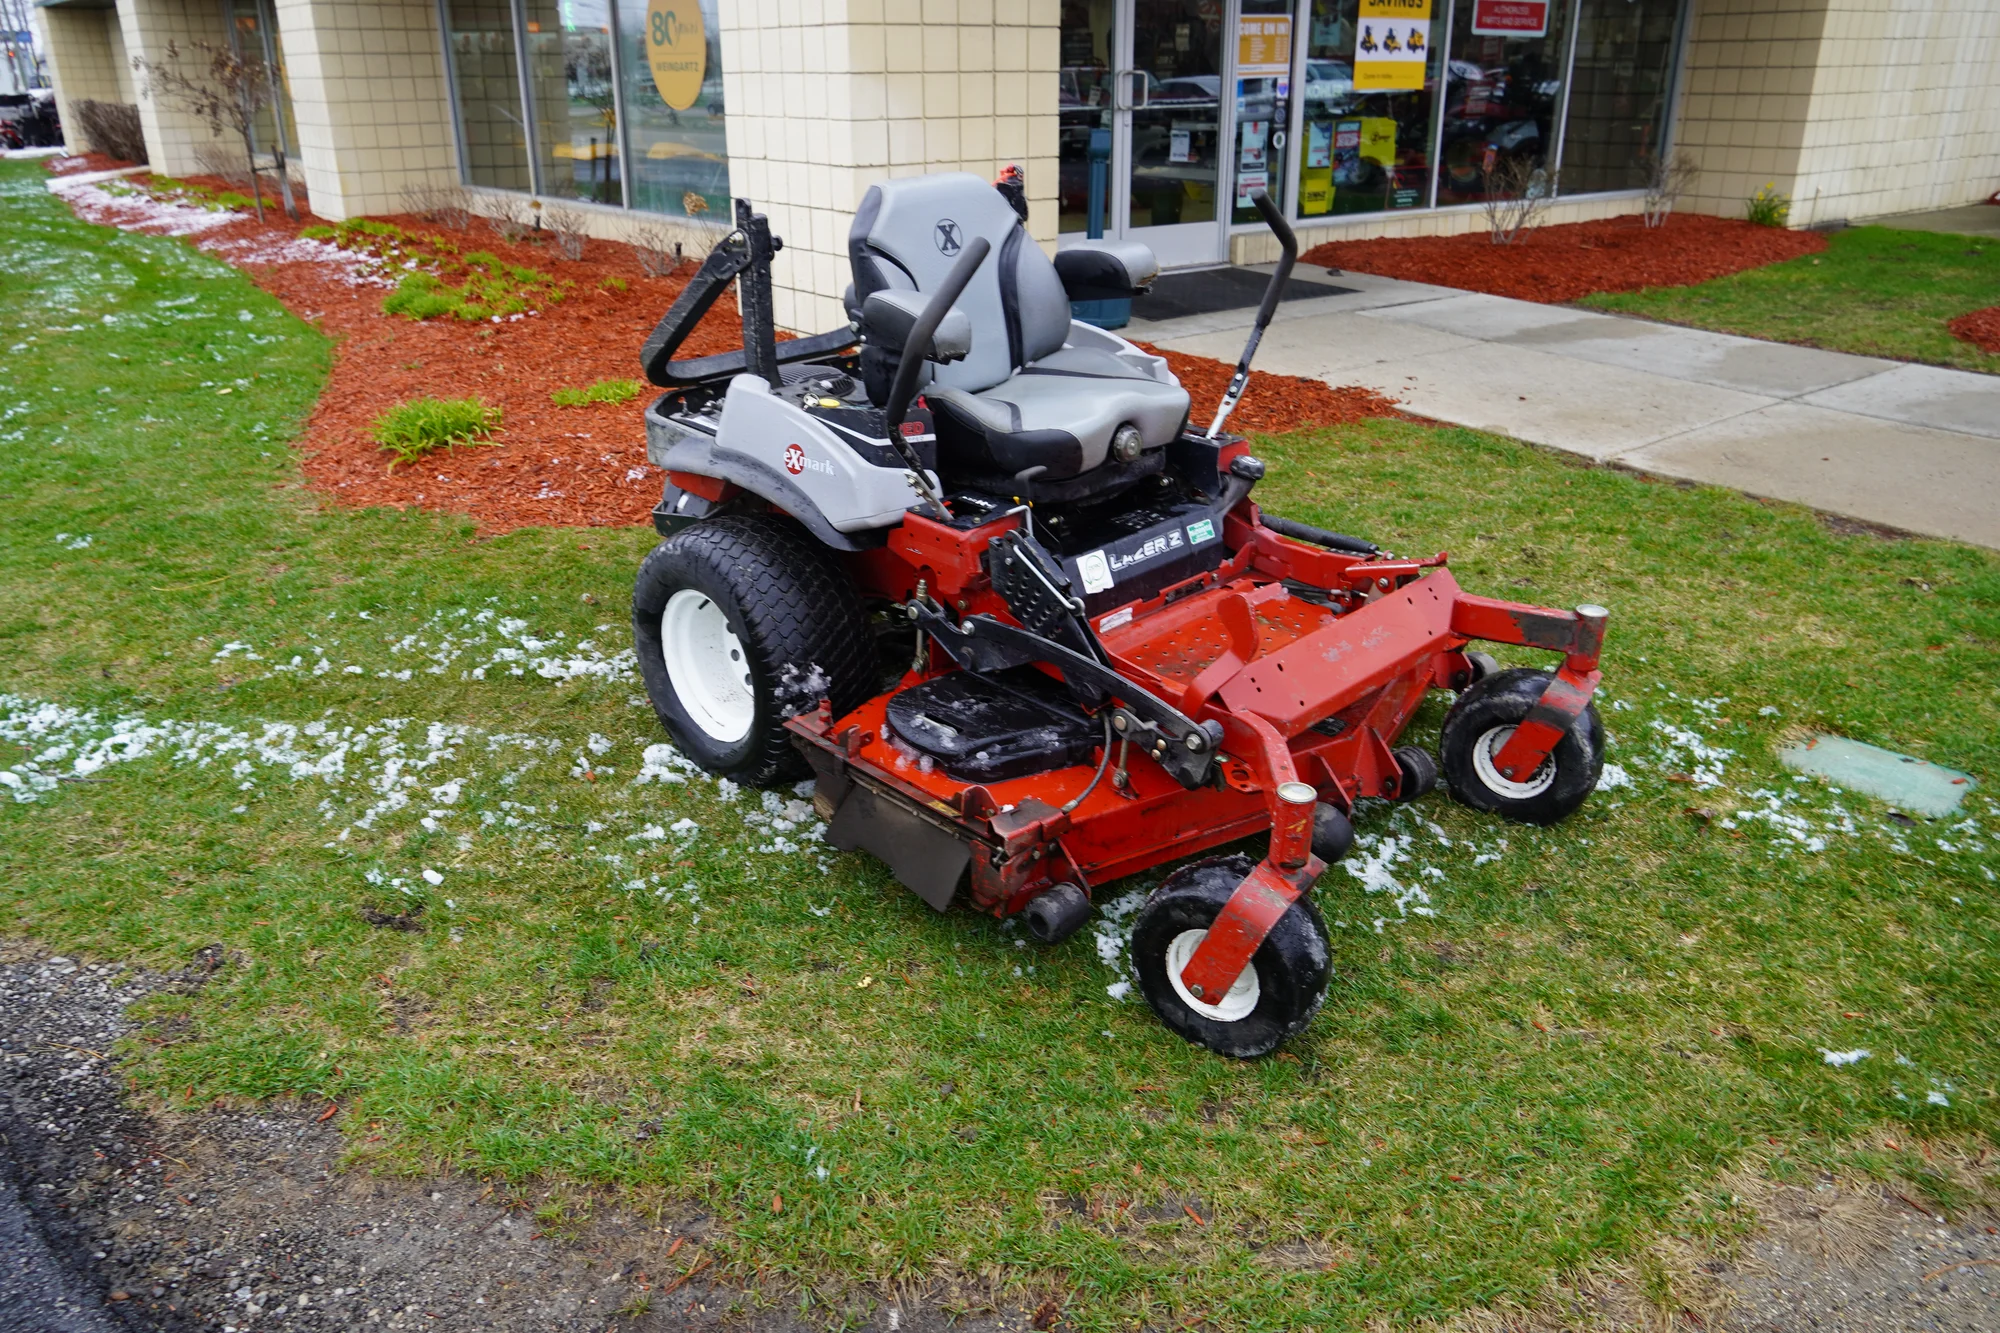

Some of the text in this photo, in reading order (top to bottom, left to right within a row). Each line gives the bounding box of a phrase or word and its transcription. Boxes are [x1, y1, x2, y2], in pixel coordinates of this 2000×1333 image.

[1239, 22, 1262, 36] COME
[1263, 22, 1275, 36] ON
[655, 61, 701, 72] WEINGARTZ
[936, 223, 961, 251] X
